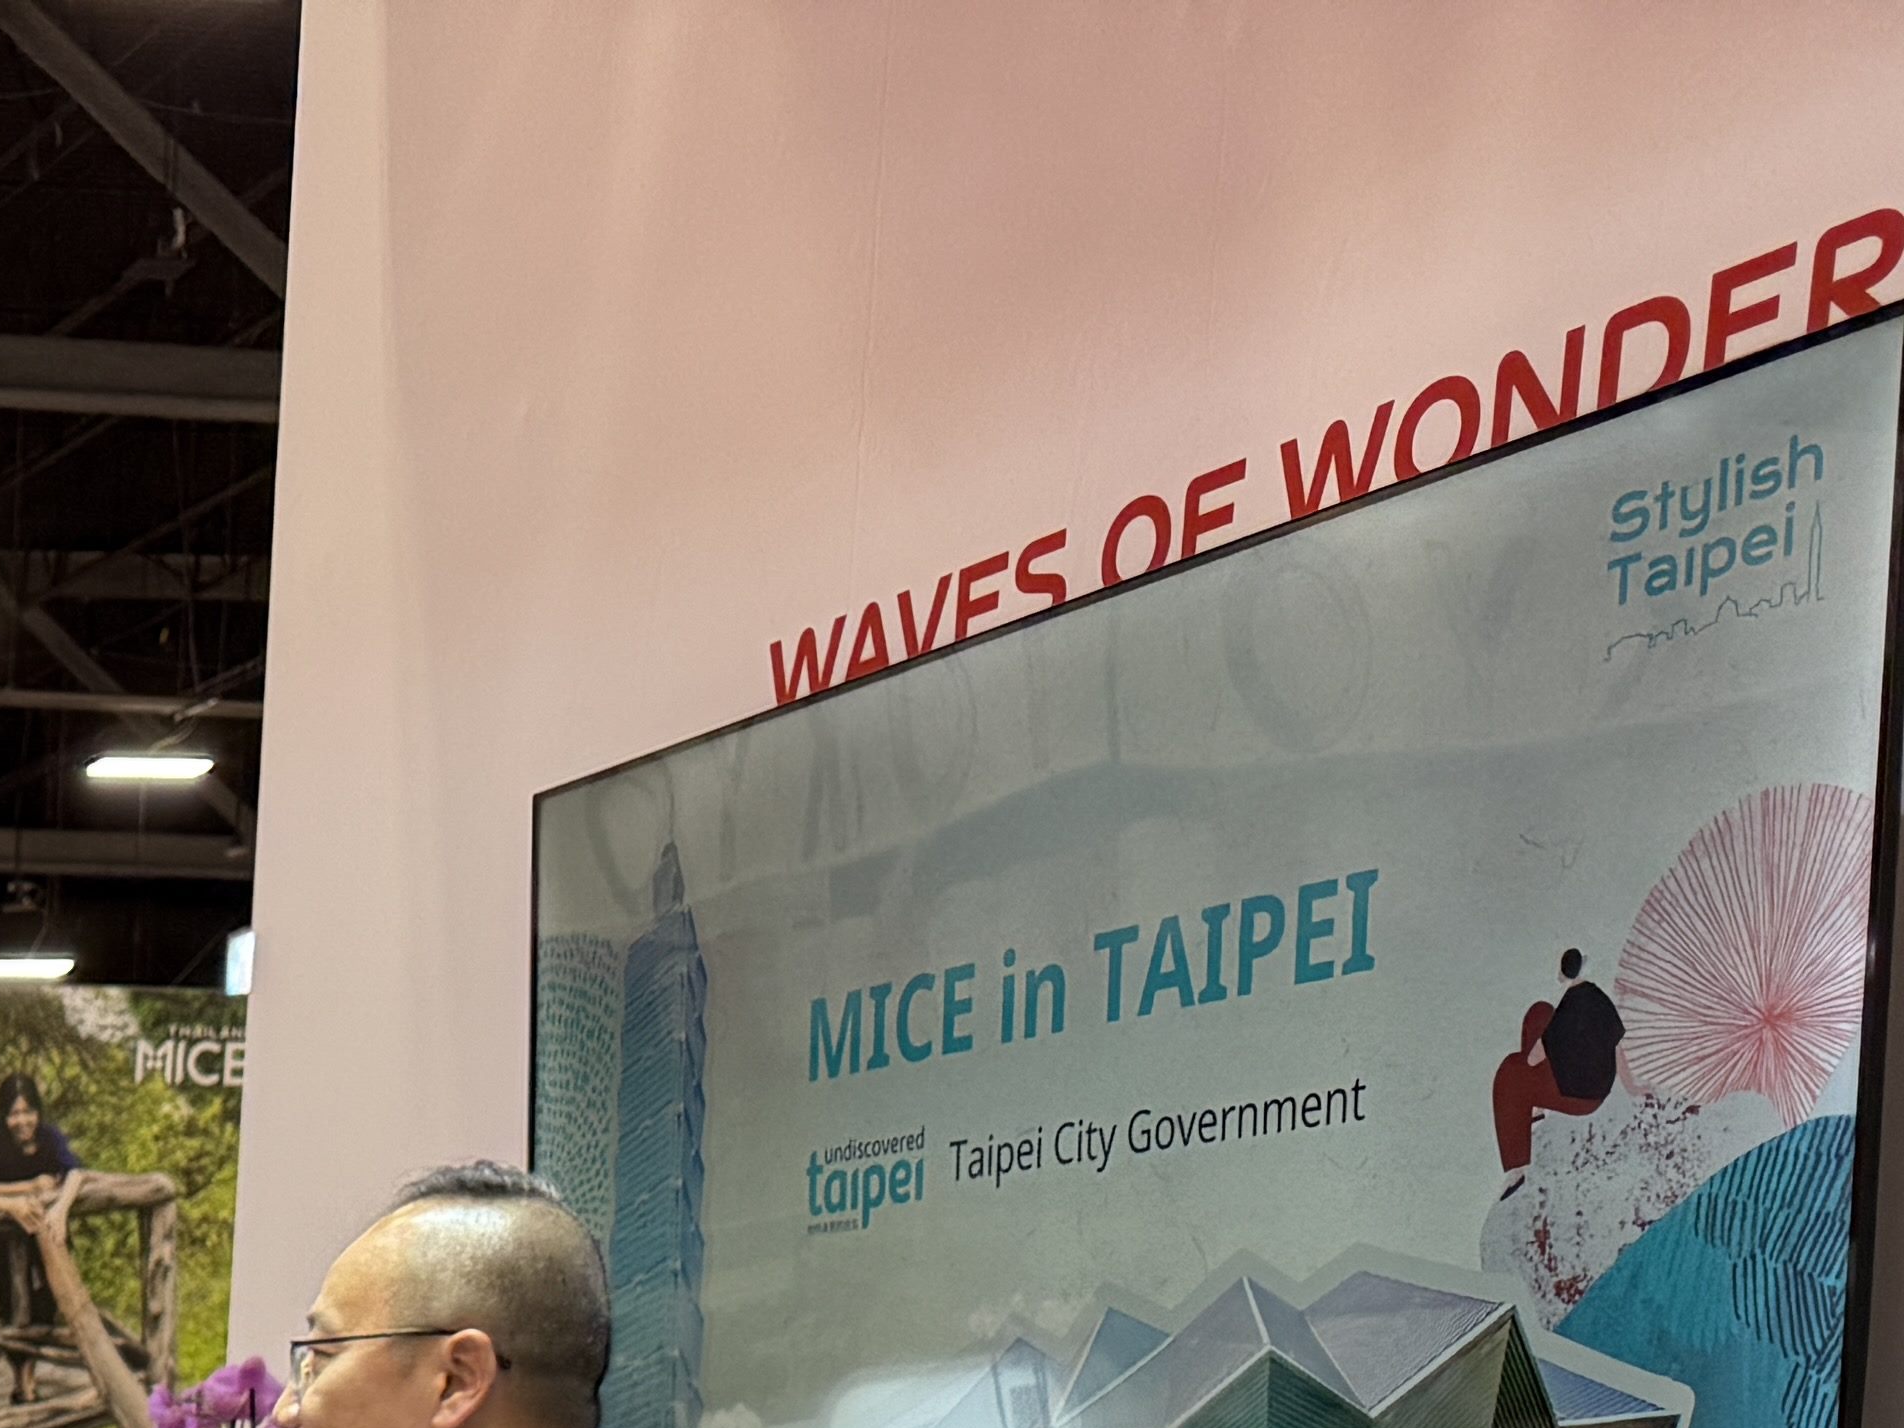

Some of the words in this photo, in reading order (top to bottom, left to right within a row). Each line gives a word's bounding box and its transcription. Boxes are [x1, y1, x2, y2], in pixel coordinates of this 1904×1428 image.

[1609, 435, 1824, 544] Stylish
[770, 528, 1067, 706] WAVES
[1101, 458, 1247, 588] OF
[1607, 502, 1796, 607] Taipei
[807, 963, 976, 1083] MICE
[1000, 948, 1067, 1045] in
[1093, 868, 1380, 1024] TAIPEI
[134, 1039, 246, 1087] MICE
[824, 1124, 925, 1165] undiscovered
[949, 1127, 1043, 1190] Taipei
[1054, 1117, 1117, 1174] City
[1128, 1077, 1367, 1155] Government
[806, 1150, 925, 1230] taipei
